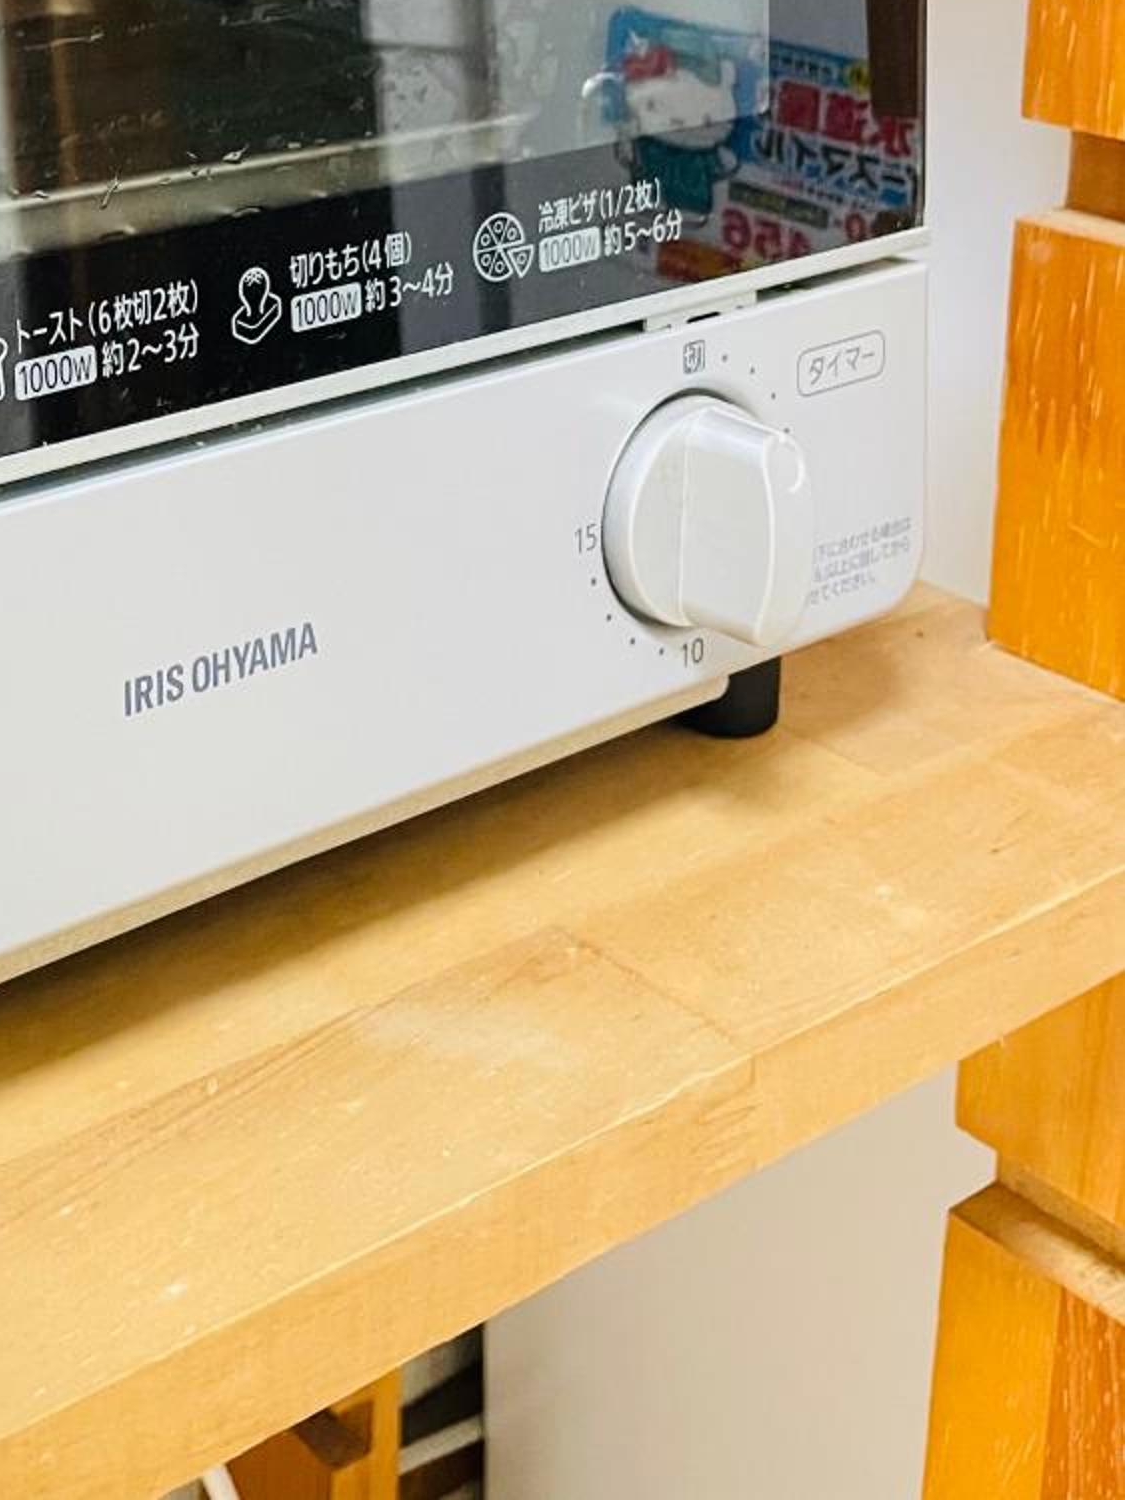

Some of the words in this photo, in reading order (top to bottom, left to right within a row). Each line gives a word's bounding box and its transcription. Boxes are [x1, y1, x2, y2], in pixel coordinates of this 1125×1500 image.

[290, 231, 412, 288] 切りもち(4個)
[808, 346, 876, 386] タイマー
[574, 523, 598, 554] 15
[124, 663, 185, 717] IRIS
[191, 621, 319, 693] OHYAMA
[681, 637, 705, 668] 10
